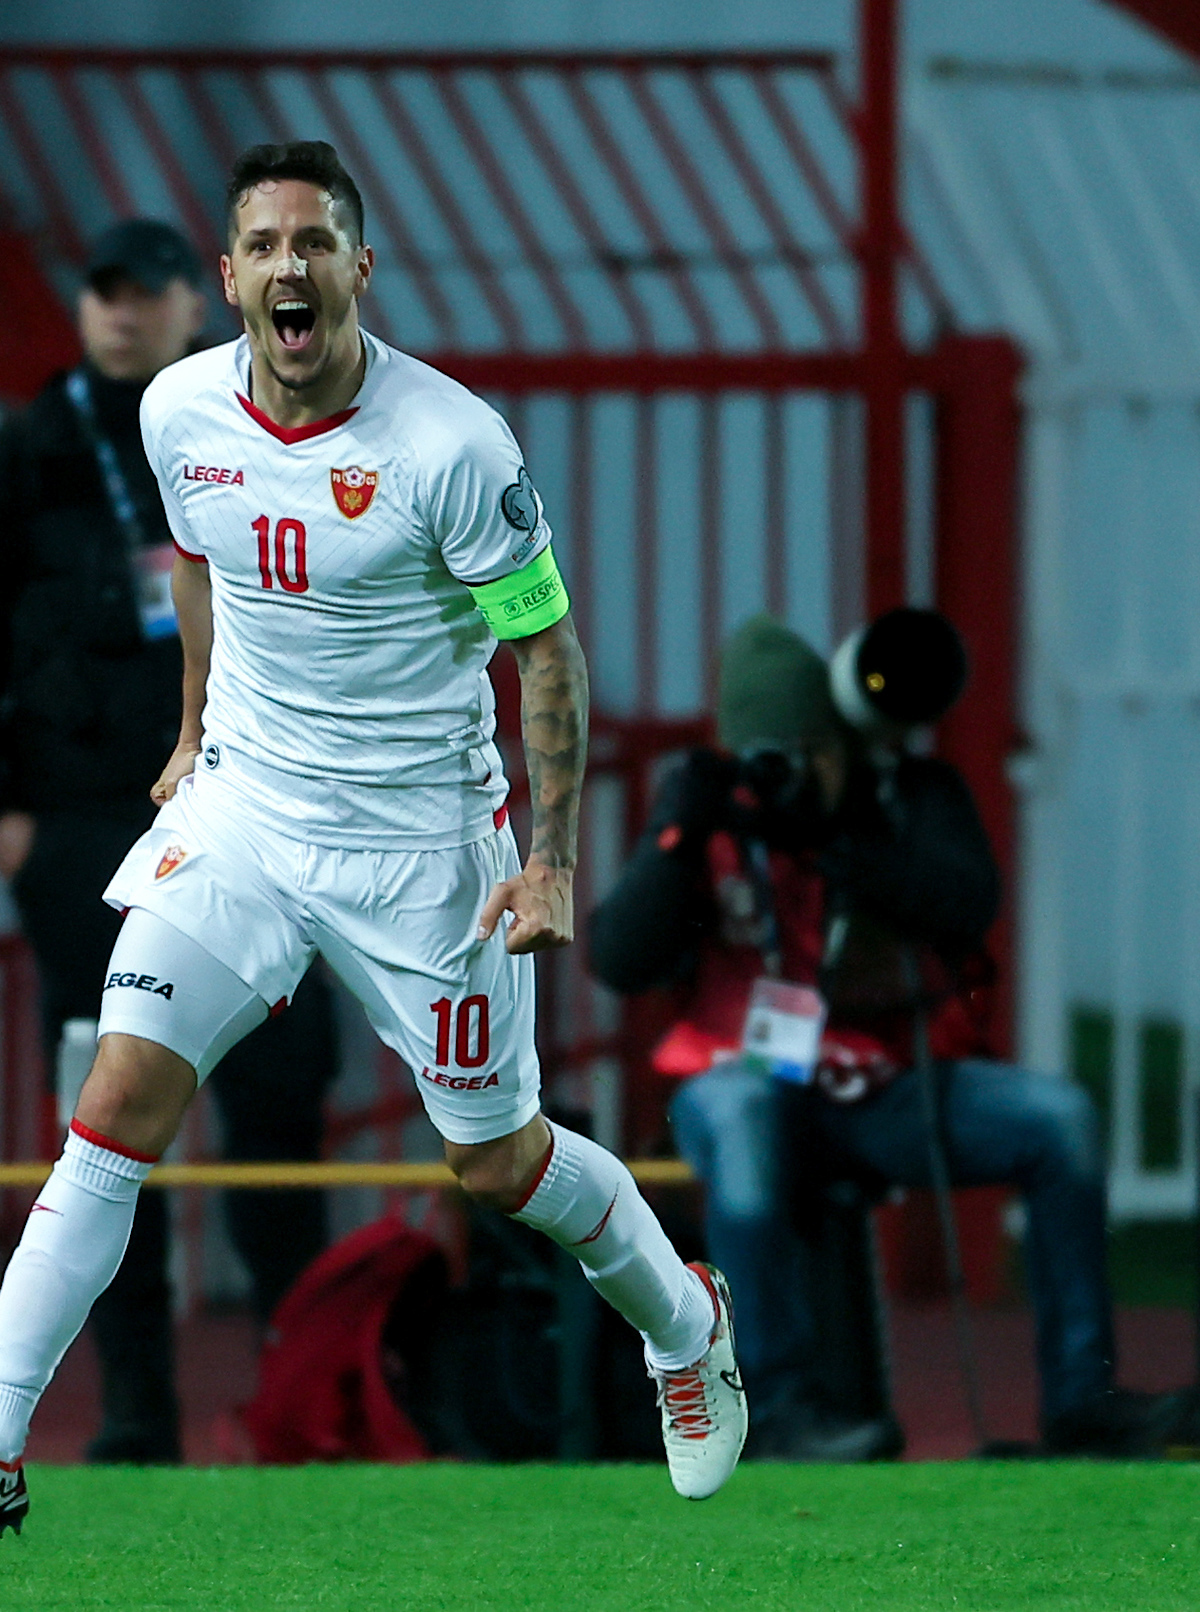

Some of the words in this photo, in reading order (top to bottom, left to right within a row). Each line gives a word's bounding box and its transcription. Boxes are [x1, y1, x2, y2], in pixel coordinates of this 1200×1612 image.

[184, 464, 244, 486] LEGEA
[251, 514, 309, 593] 10
[522, 573, 560, 609] RESPEC
[429, 994, 490, 1068] 10
[422, 1066, 499, 1091] LEGEA
